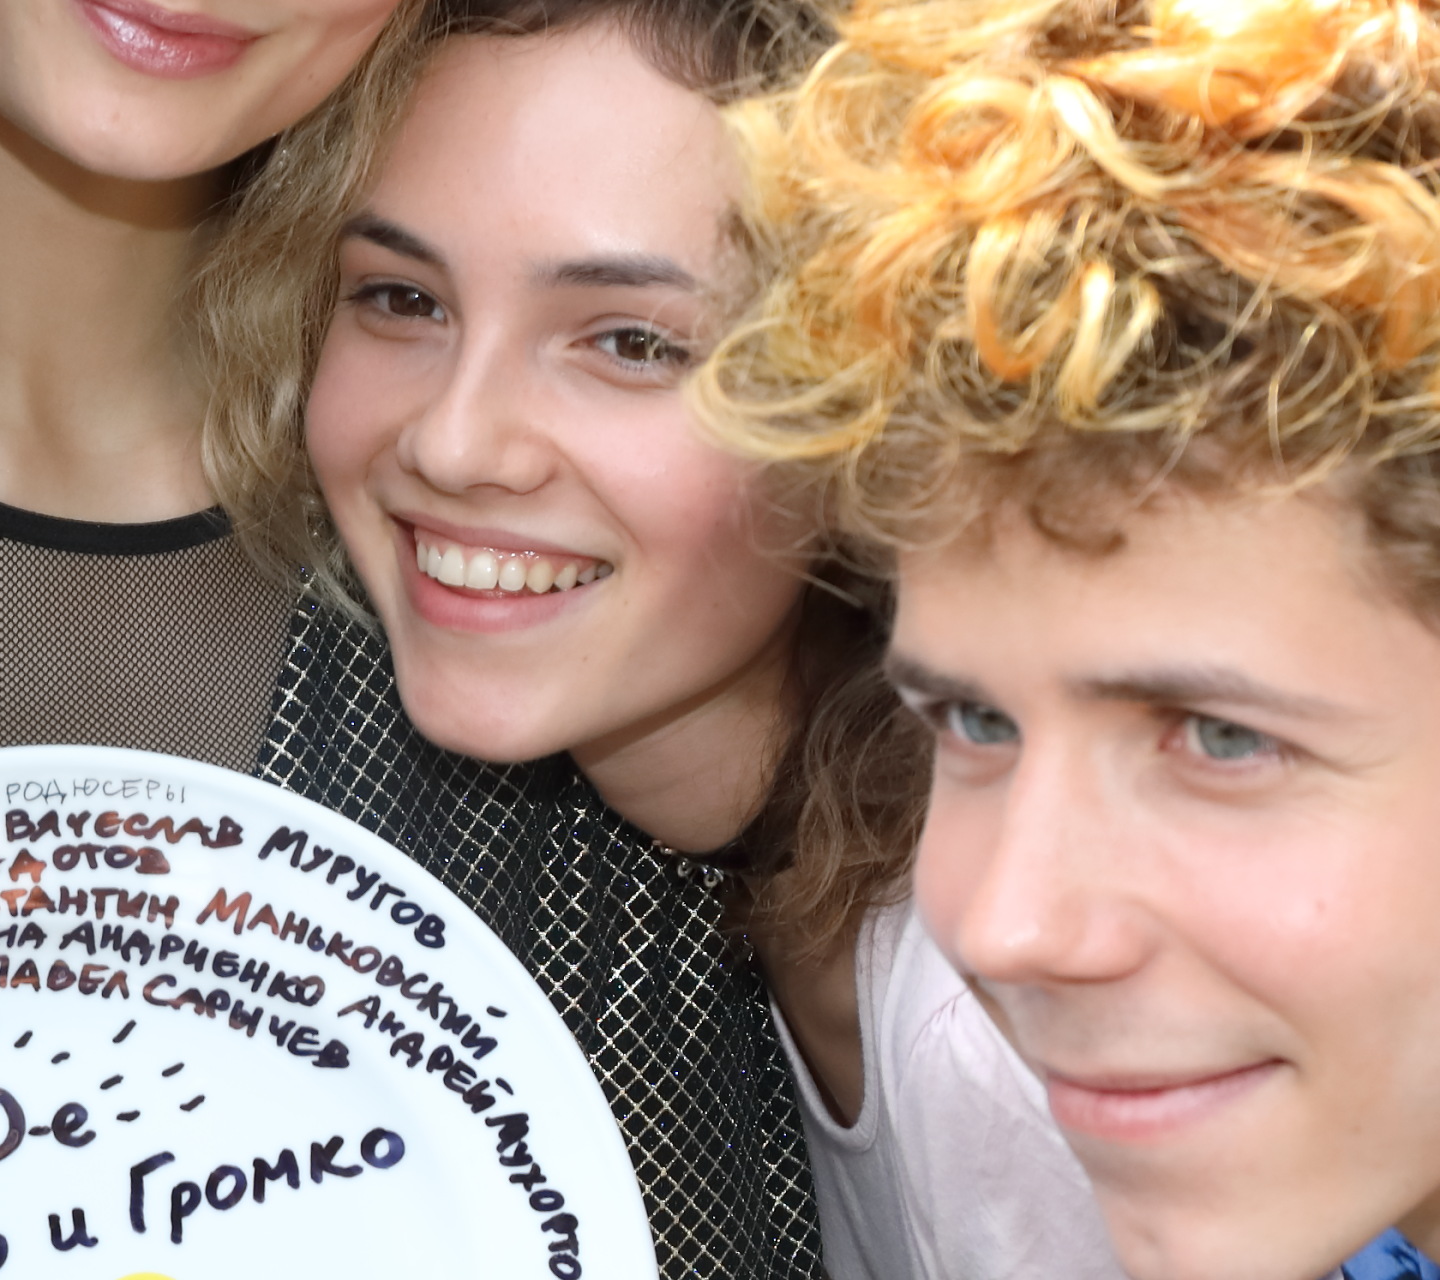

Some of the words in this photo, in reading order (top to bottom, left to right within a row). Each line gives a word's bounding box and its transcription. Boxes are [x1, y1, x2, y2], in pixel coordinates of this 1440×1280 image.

[258, 825, 447, 950] МУРУГОВ
[59, 920, 326, 1008] АНДРИЕНКО
[336, 995, 515, 1114] АНДРЕЙ
[142, 972, 351, 1070] САРЫЧЕВ
[196, 887, 507, 1060] МАНЬКОВСКИЙ
[47, 1206, 99, 1253] и
[127, 1126, 407, 1245] Громко
